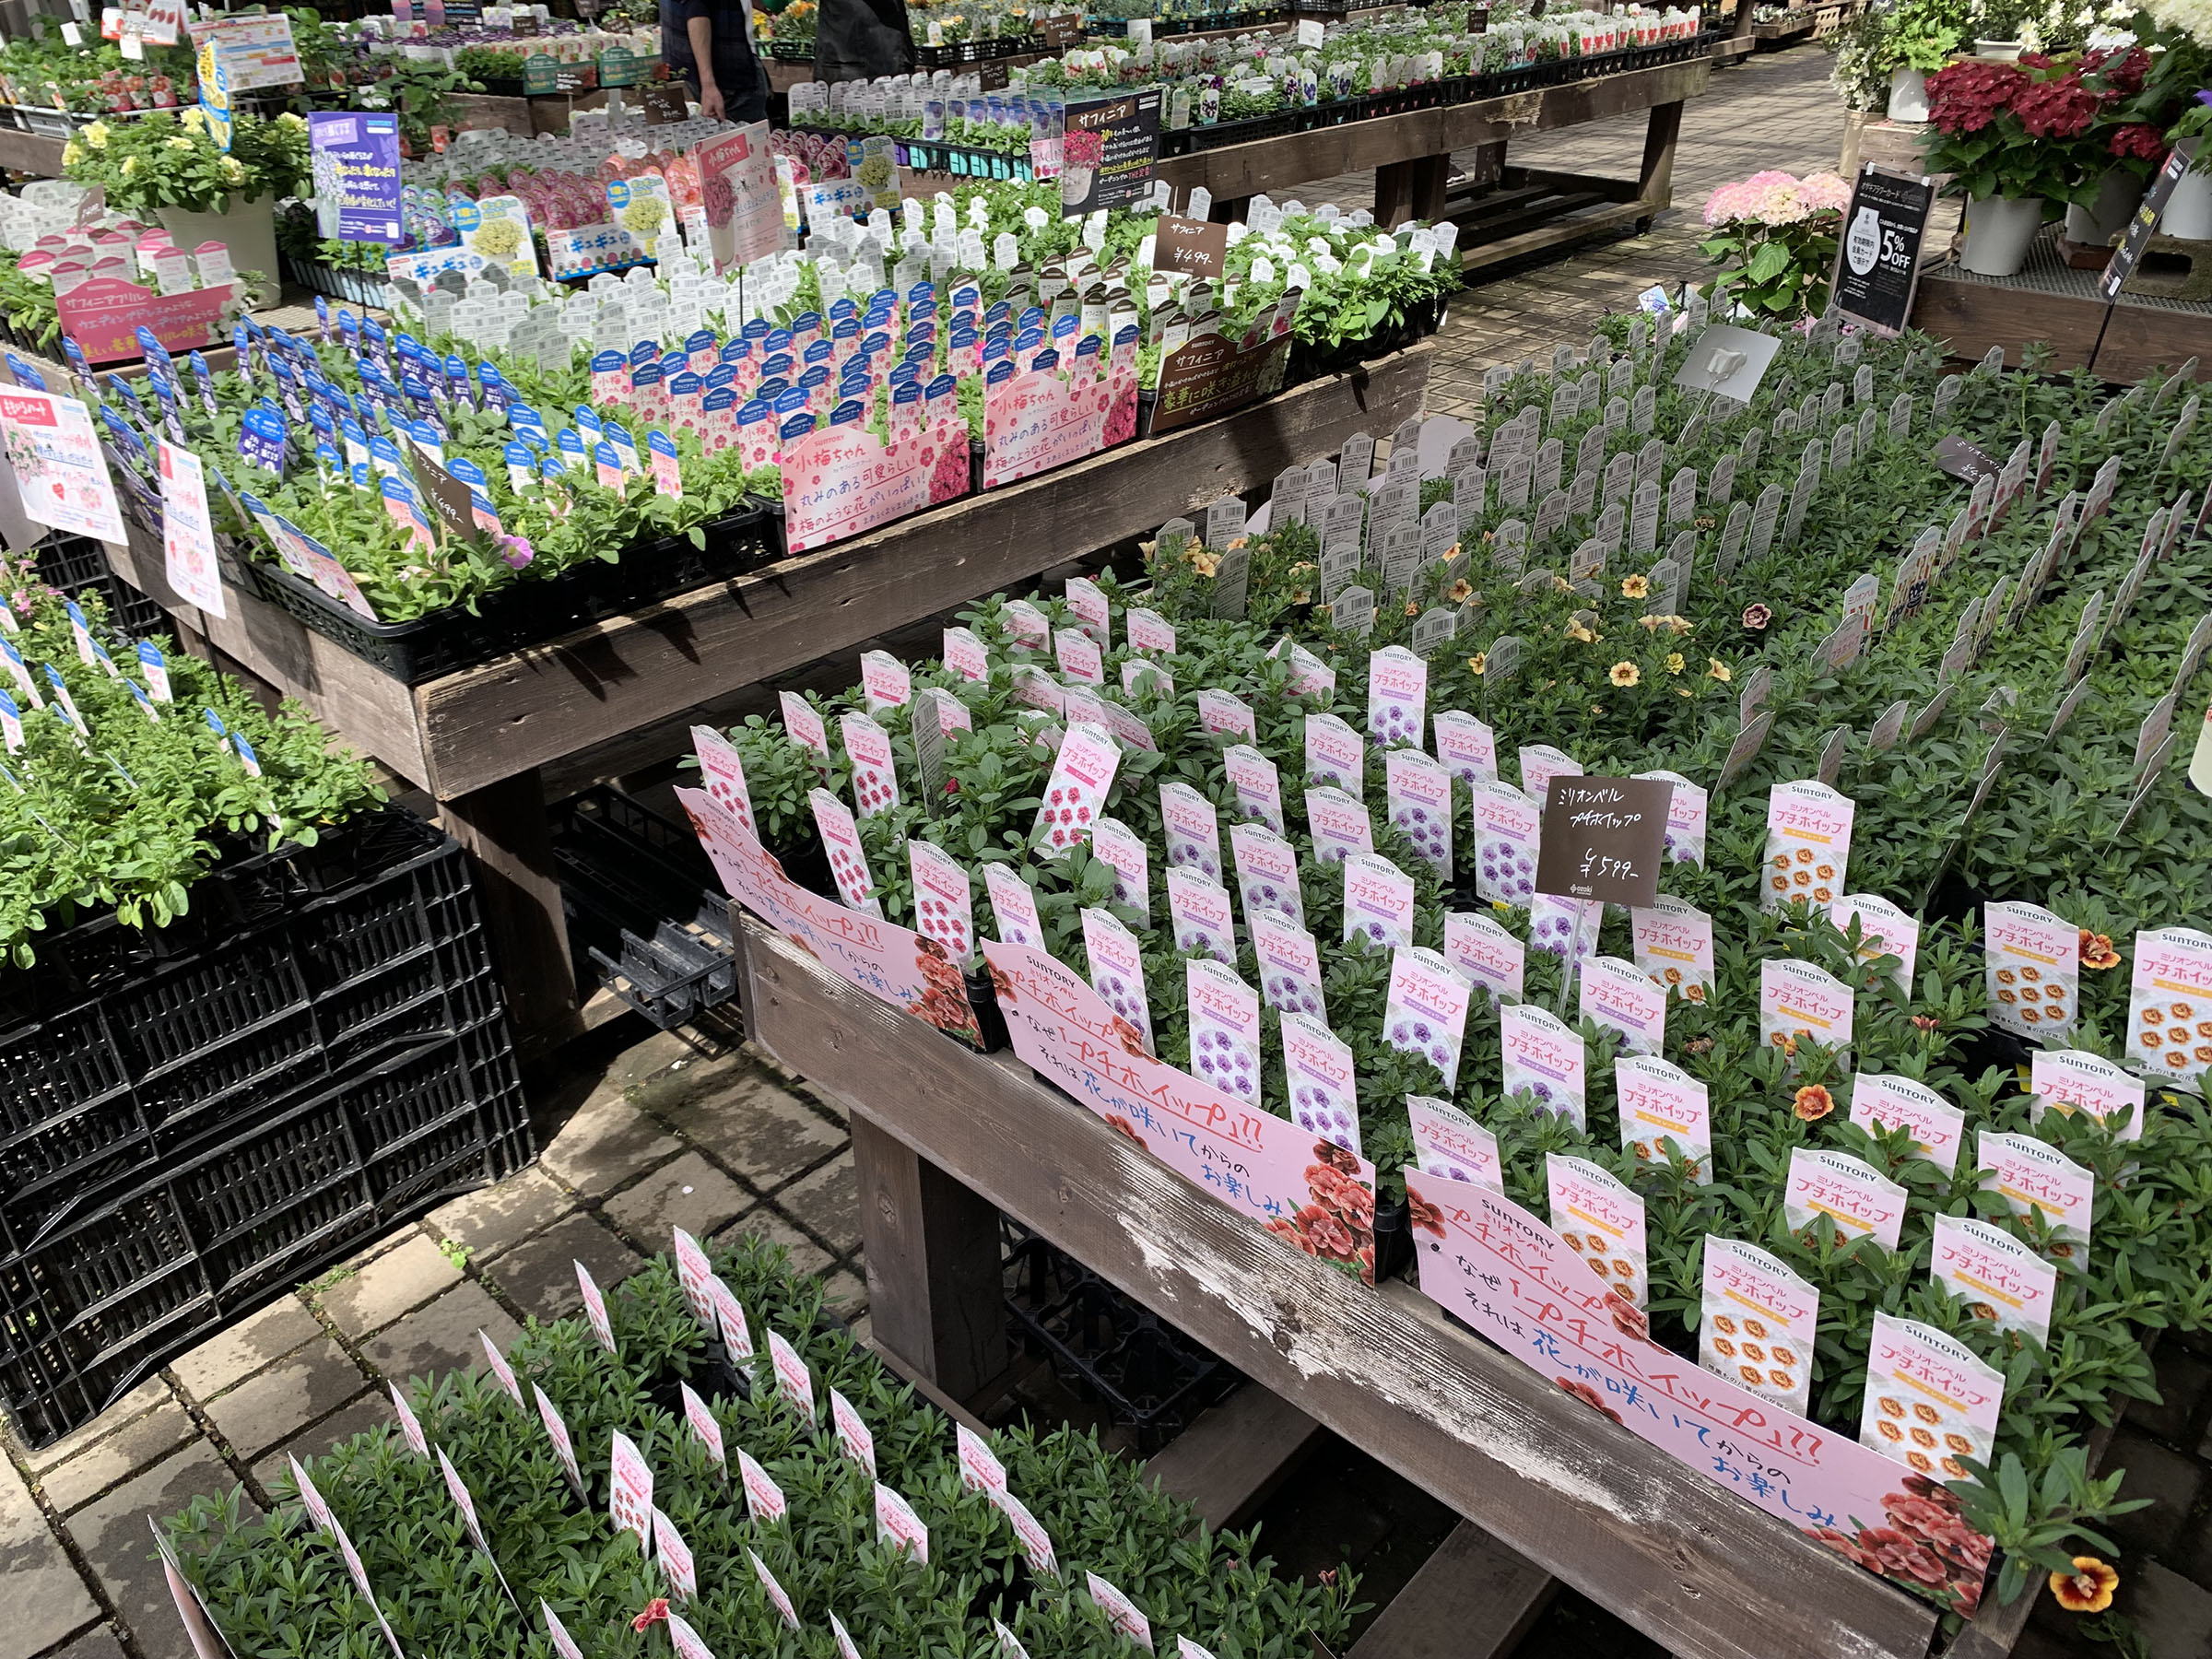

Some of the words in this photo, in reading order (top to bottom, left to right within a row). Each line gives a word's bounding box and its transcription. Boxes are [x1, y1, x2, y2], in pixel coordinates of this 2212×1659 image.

[1078, 104, 1126, 127] サフィニア
[1171, 223, 1205, 235] サフィニア
[1891, 253, 1911, 268] OFF
[1176, 349, 1225, 368] サフィニア
[598, 372, 621, 386] 小梅
[896, 406, 915, 418] 小梅
[931, 397, 950, 411] 小梅
[998, 389, 1054, 415] 小梅ちゃん
[745, 424, 767, 440] 小梅
[814, 435, 844, 447] SUNTORY
[796, 443, 866, 473] 小梅ちゃん
[1137, 612, 1161, 624] SUNTORY
[1131, 629, 1171, 650] プチホイップ
[871, 654, 896, 666] SUNTORY
[1383, 651, 1413, 662] SUNTORY
[1374, 673, 1422, 692] プチホイップ
[1383, 666, 1412, 678] ミリオンベル
[865, 675, 908, 695] プチホイップ
[1209, 692, 1238, 706] SUNTORY
[849, 716, 875, 729] SUNTORY
[1204, 710, 1250, 733] プチホイップ
[1211, 706, 1239, 720] ミリオンベル
[1081, 725, 1109, 745] SUNTORY
[845, 737, 888, 759] プチホイップ
[1076, 743, 1102, 763] ミリオンベル
[1063, 747, 1111, 780] プチホイップ
[1401, 753, 1433, 768] SUNTORY
[1392, 773, 1446, 798] プチホイップ
[1402, 768, 1434, 783] ミリオンベル
[1558, 788, 1624, 806] ミリオンベル
[1792, 785, 1833, 799] SUNTORY
[1570, 812, 1641, 828] プチホイップ
[1776, 809, 1846, 835] プチホイップ
[1790, 803, 1831, 819] ミリオンベル
[1243, 828, 1277, 843] SUNTORY
[921, 844, 952, 865] SUNTORY
[1239, 848, 1293, 875] プチホイップ
[1247, 844, 1279, 861] ミリオンベル
[924, 861, 954, 880] ミリオンベル
[1360, 857, 1395, 877] SUNTORY
[915, 862, 965, 897] プチホイップ
[1360, 876, 1395, 894] ミリオンベル
[1349, 880, 1408, 912] プチホイップ
[1263, 912, 1296, 932] SUNTORY
[2006, 906, 2053, 924] SUNTORY
[1265, 930, 1300, 950] ミリオンベル
[1992, 928, 2072, 958] プチホイップ
[2006, 923, 2053, 941] ミリオンベル
[1258, 935, 1313, 967] プチホイップ
[1027, 955, 1076, 988] SUNTORY
[1412, 951, 1452, 975] SUNTORY
[1601, 961, 1644, 983] SUNTORY
[853, 967, 913, 1000] お楽しみ
[1030, 969, 1078, 1001] ミリオンベル
[1396, 975, 1463, 1014] プチホイップ
[1410, 971, 1449, 995] ミリオンベル
[1601, 980, 1643, 1002] ミリオンベル
[1008, 969, 1114, 1037] プチホイップ
[1587, 983, 1660, 1020] プチホイップ
[1296, 1018, 1332, 1041] SUNTORY
[1519, 1010, 1561, 1032] SUNTORY
[1298, 1037, 1335, 1061] ミリオンベル
[1520, 1030, 1562, 1053] ミリオンベル
[1288, 1041, 1349, 1080] プチホイップ
[1508, 1036, 1579, 1073] プチホイップ
[1635, 1062, 1681, 1081] SUNTORY
[1637, 1082, 1684, 1103] ミリオンベル
[1426, 1102, 1471, 1126] SUNTORY
[1624, 1088, 1702, 1124] プチホイップ
[1417, 1122, 1493, 1164] プチホイップ
[1429, 1120, 1475, 1145] ミリオンベル
[1568, 1161, 1617, 1188] SUNTORY
[1818, 1154, 1877, 1182] SUNTORY
[1202, 1164, 1283, 1216] お楽しみ
[1570, 1181, 1619, 1209] ミリオンベル
[1796, 1178, 1895, 1222] プチホイップ
[1818, 1175, 1874, 1203] ミリオンベル
[1556, 1183, 1639, 1231] プチホイップ
[1482, 1199, 1555, 1250] SUNTORY
[1482, 1212, 1555, 1263] ミリオンベル
[1962, 1224, 2023, 1256] SUNTORY
[1444, 1204, 1604, 1311] プチホイップ
[1732, 1245, 1788, 1277] SUNTORY
[1961, 1244, 2021, 1277] ミリオンベル
[1730, 1265, 1788, 1298] ミリオンベル
[1941, 1247, 2044, 1300] プチホイップ
[1712, 1265, 1809, 1319] プチホイップ
[1904, 1324, 1970, 1362] SUNTORY
[1880, 1344, 1992, 1406] プチホイップ
[1901, 1345, 1967, 1382] ミリオンベル
[1712, 1456, 1838, 1528] お楽しみ
